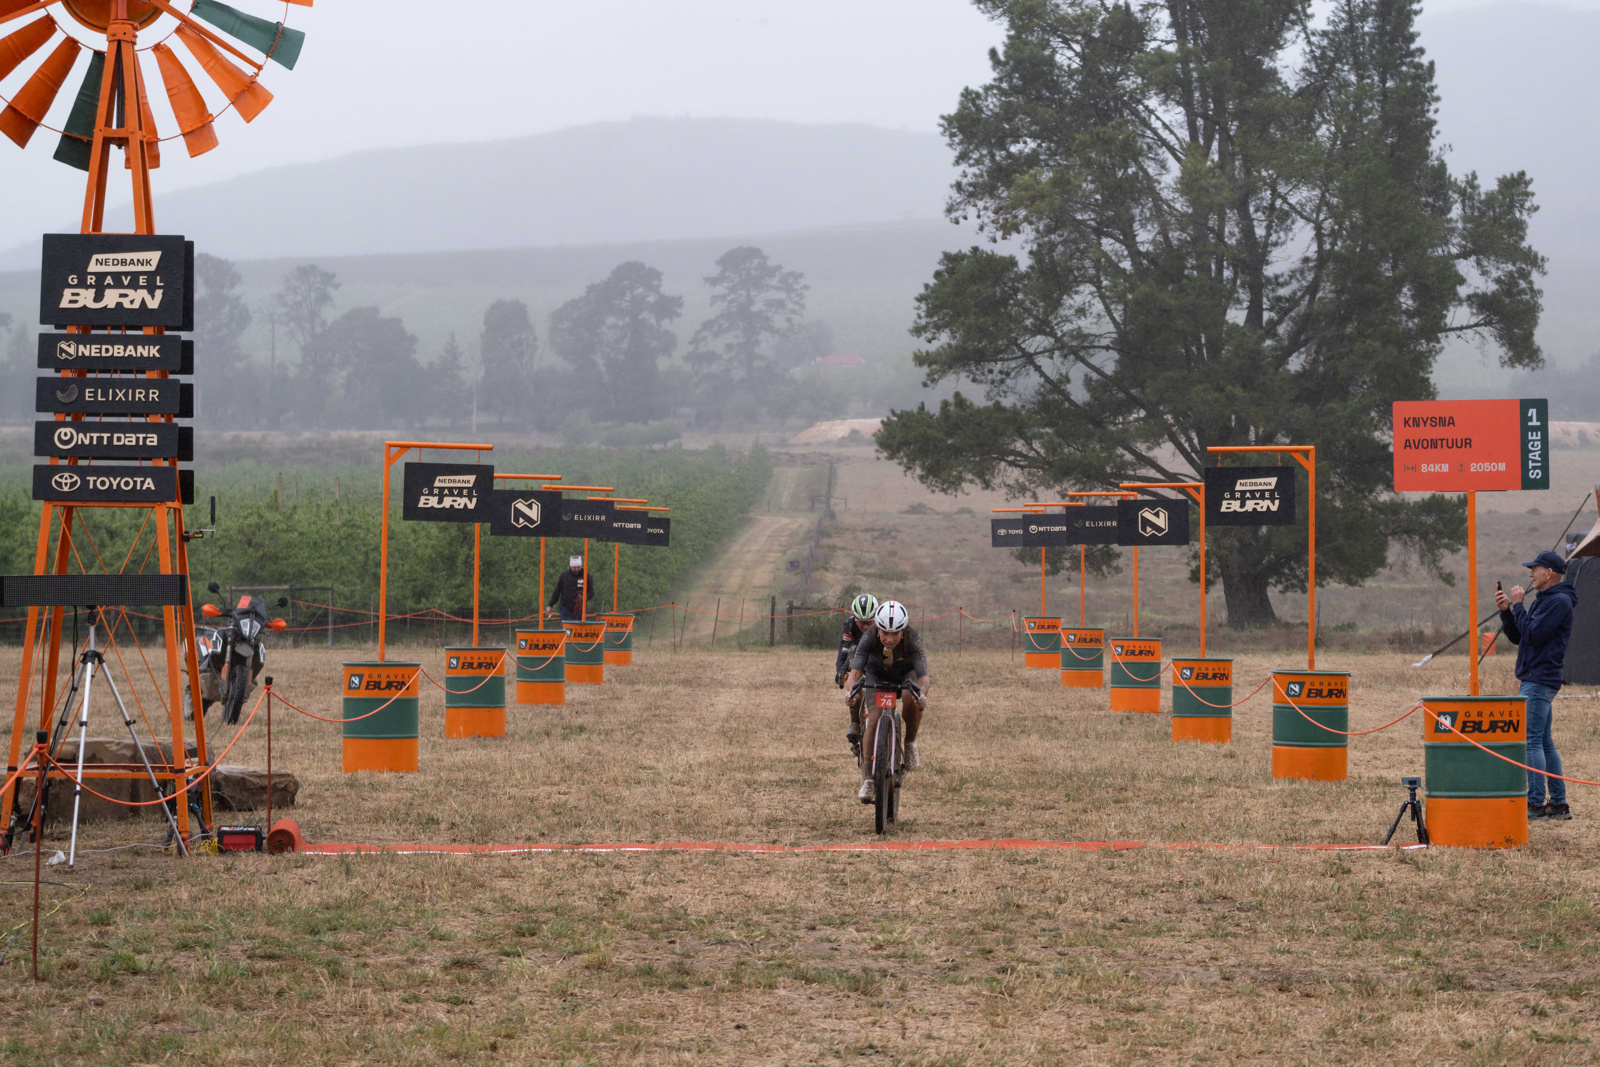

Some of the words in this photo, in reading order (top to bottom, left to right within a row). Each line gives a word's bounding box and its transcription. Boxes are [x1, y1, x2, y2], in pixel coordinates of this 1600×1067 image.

[94, 257, 153, 268] NEDBANK
[68, 274, 164, 286] GRAVEL
[59, 288, 164, 309] BURN
[78, 344, 160, 358] NEDBANK
[85, 388, 160, 402] ELIXIRR
[1403, 416, 1456, 428] KNYSNA
[1528, 408, 1540, 426] 1
[77, 432, 111, 446] NTT
[1403, 438, 1472, 450] AVONTUUR
[1528, 431, 1542, 479] STAGE
[1420, 463, 1449, 472] 84KM
[1470, 462, 1506, 472] 2050M
[86, 476, 156, 490] TOYOTA
[422, 488, 478, 496] GRAVEL
[418, 496, 477, 510] BURN
[1220, 500, 1280, 512] BURN
[365, 680, 410, 690] BURN
[1306, 688, 1347, 698] BURN
[1460, 720, 1520, 733] BURN
